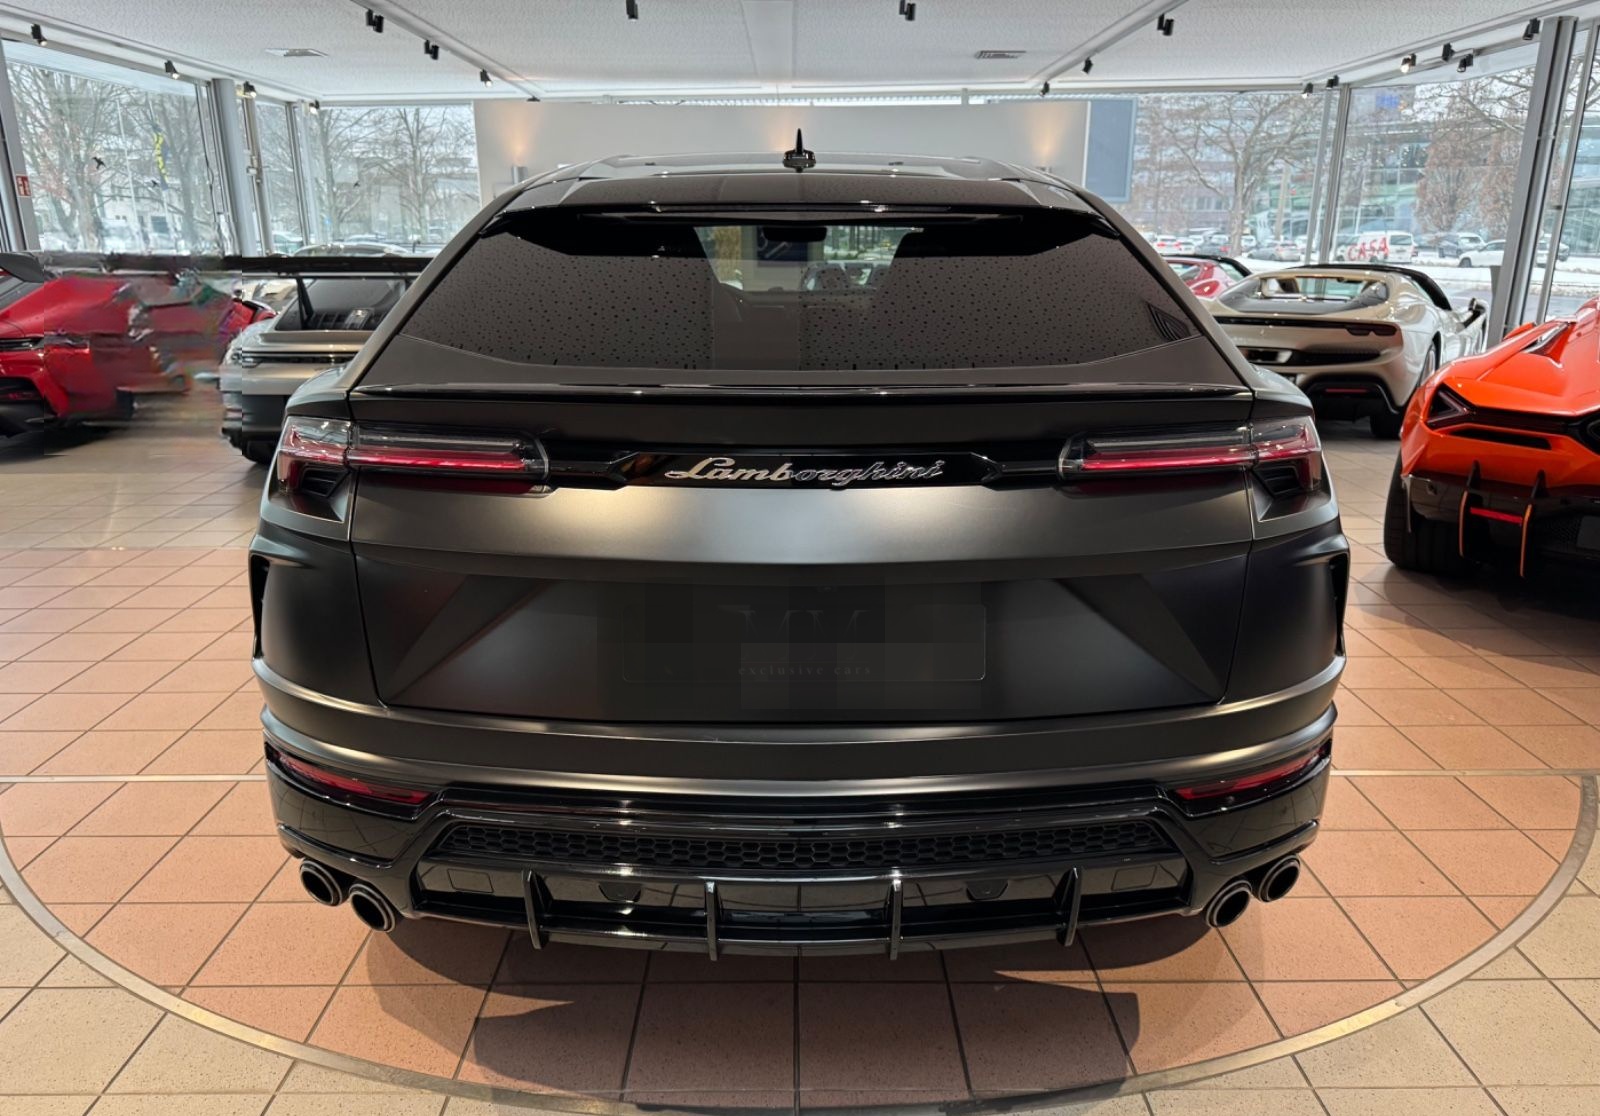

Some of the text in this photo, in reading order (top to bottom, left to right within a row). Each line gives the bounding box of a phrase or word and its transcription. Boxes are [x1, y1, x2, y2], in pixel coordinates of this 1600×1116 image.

[664, 457, 946, 486] Lamborghini
[738, 664, 871, 676] exclusive cars
